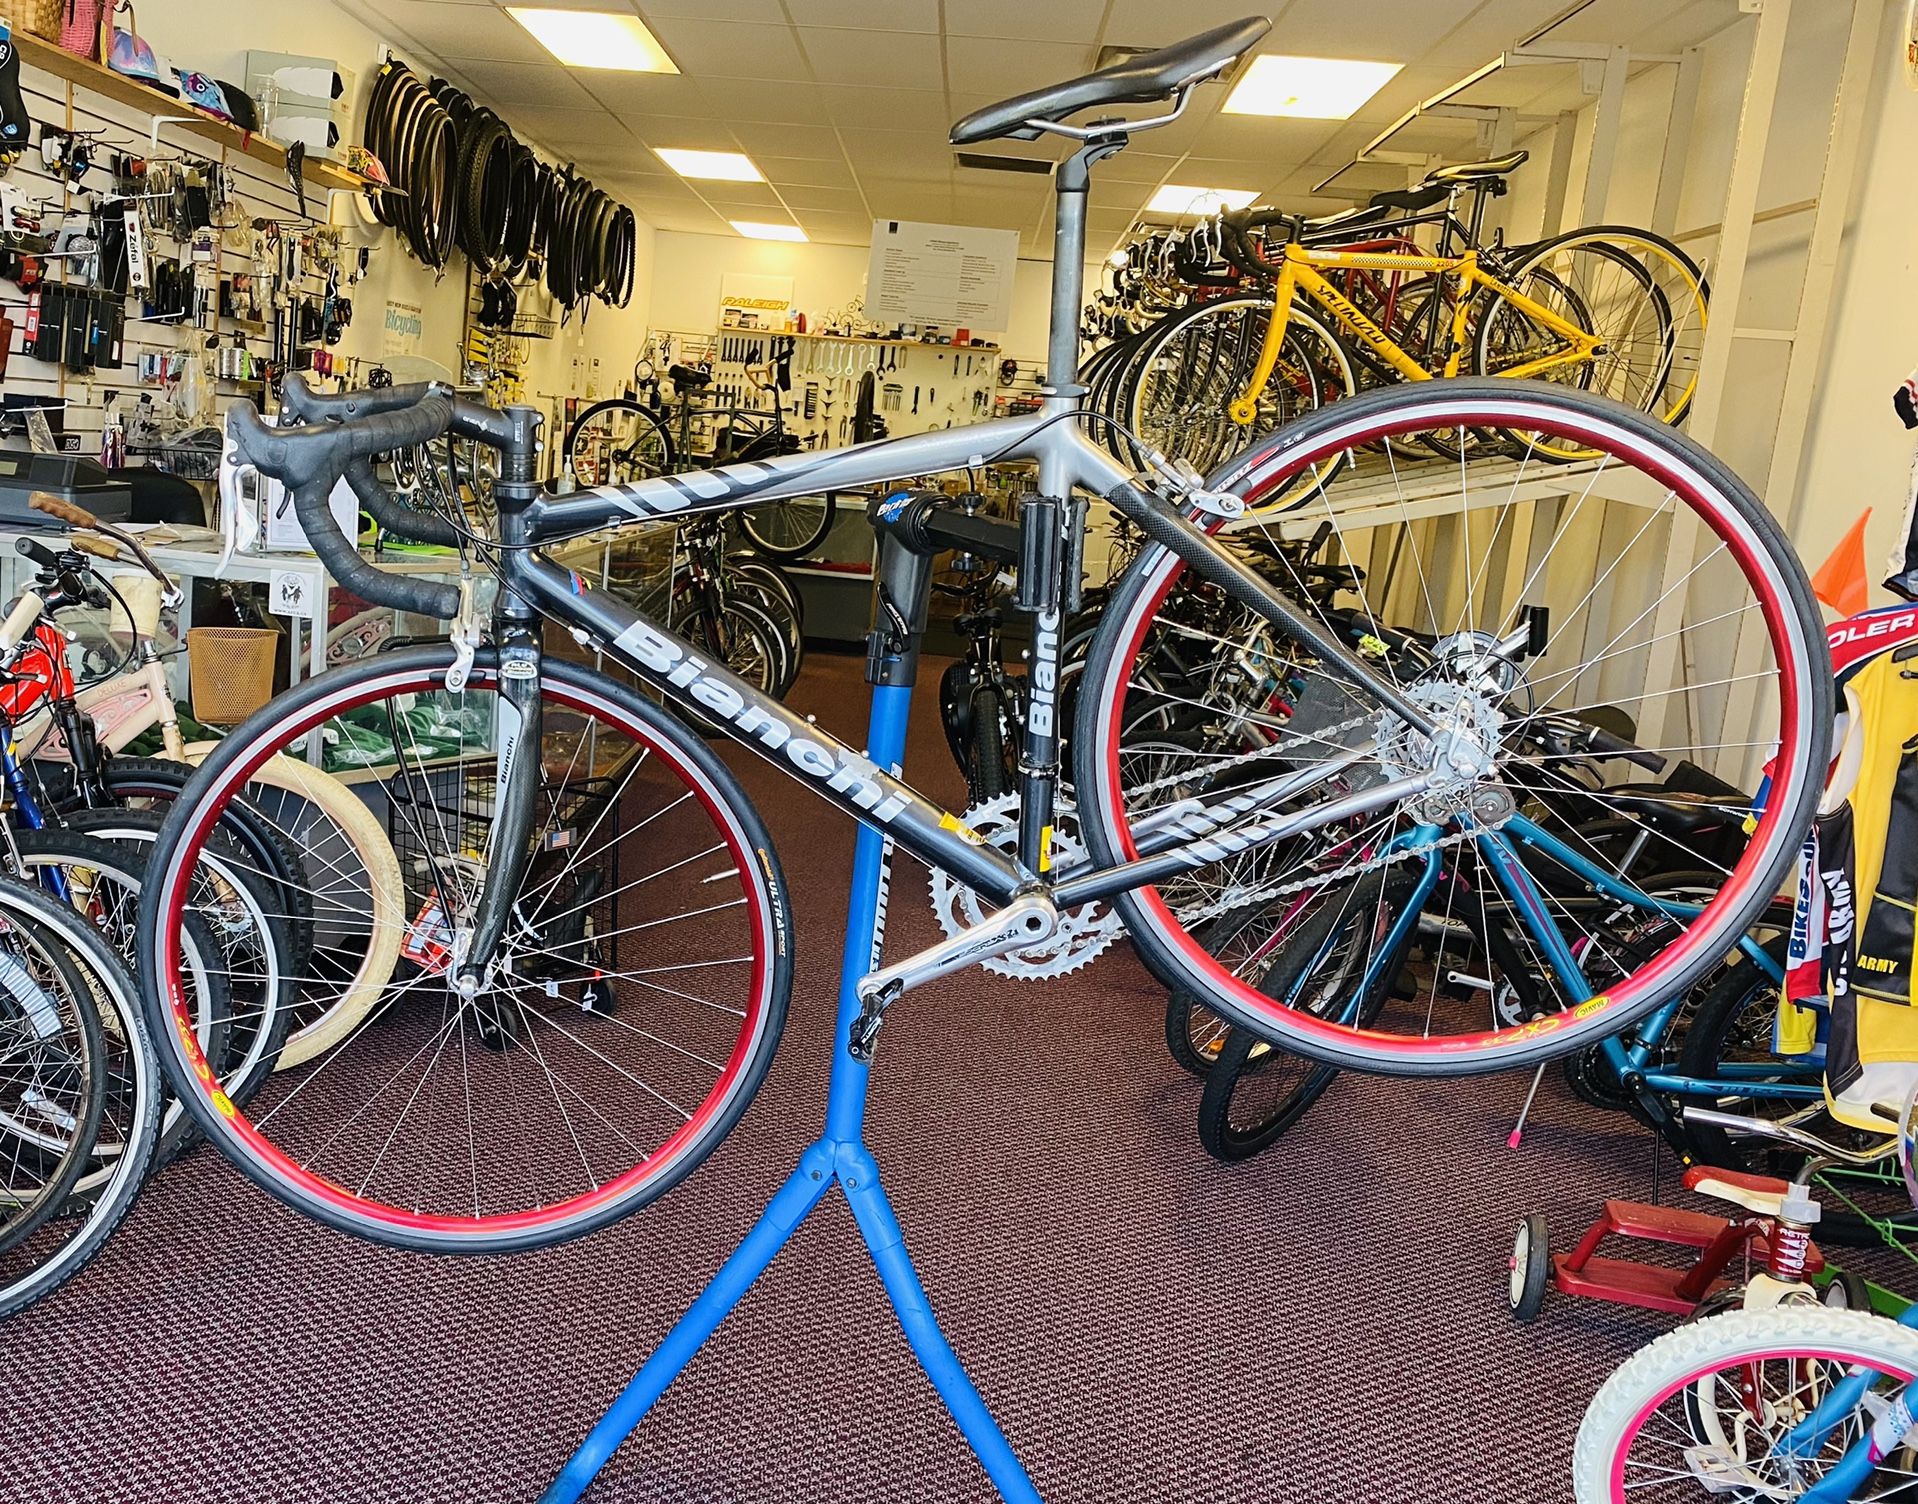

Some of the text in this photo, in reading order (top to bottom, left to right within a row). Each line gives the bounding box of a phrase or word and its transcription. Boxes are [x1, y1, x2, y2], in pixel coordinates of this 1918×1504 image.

[722, 296, 789, 311] RALEIGH
[385, 309, 421, 340] Bicycling
[1028, 560, 1064, 737] Bianc
[613, 620, 912, 823] Bianchi
[501, 736, 514, 784] Bianchi
[768, 881, 785, 929] ULTRA
[1857, 954, 1899, 974] ARMY
[1579, 999, 1605, 1016] MAVIC
